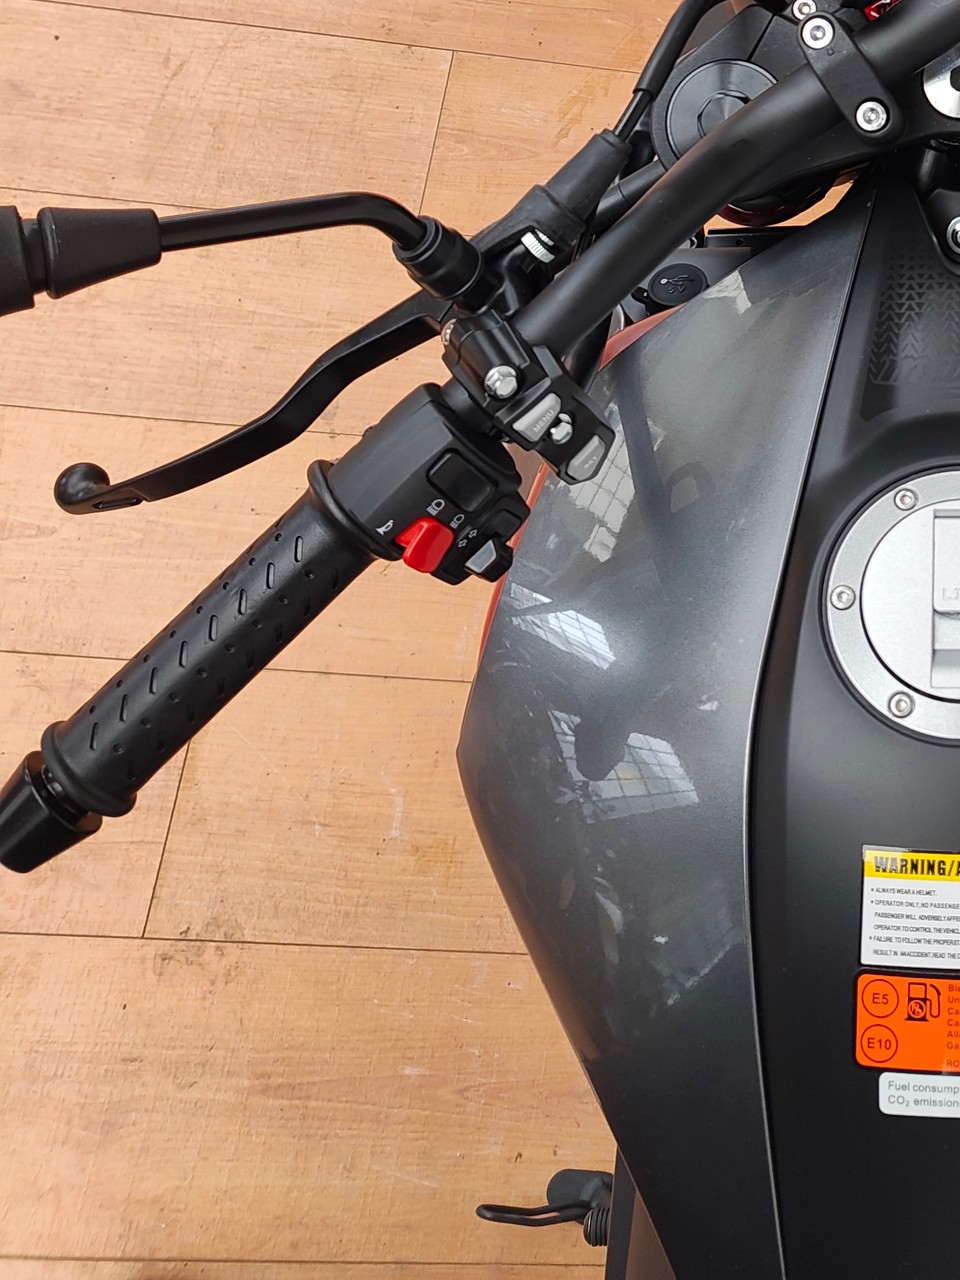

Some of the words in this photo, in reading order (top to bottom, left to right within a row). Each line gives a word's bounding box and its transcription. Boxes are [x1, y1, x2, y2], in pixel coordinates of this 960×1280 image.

[532, 409, 554, 433] MENU
[872, 992, 889, 1005] E5
[867, 1037, 892, 1051] E10
[888, 1081, 910, 1092] Fuel
